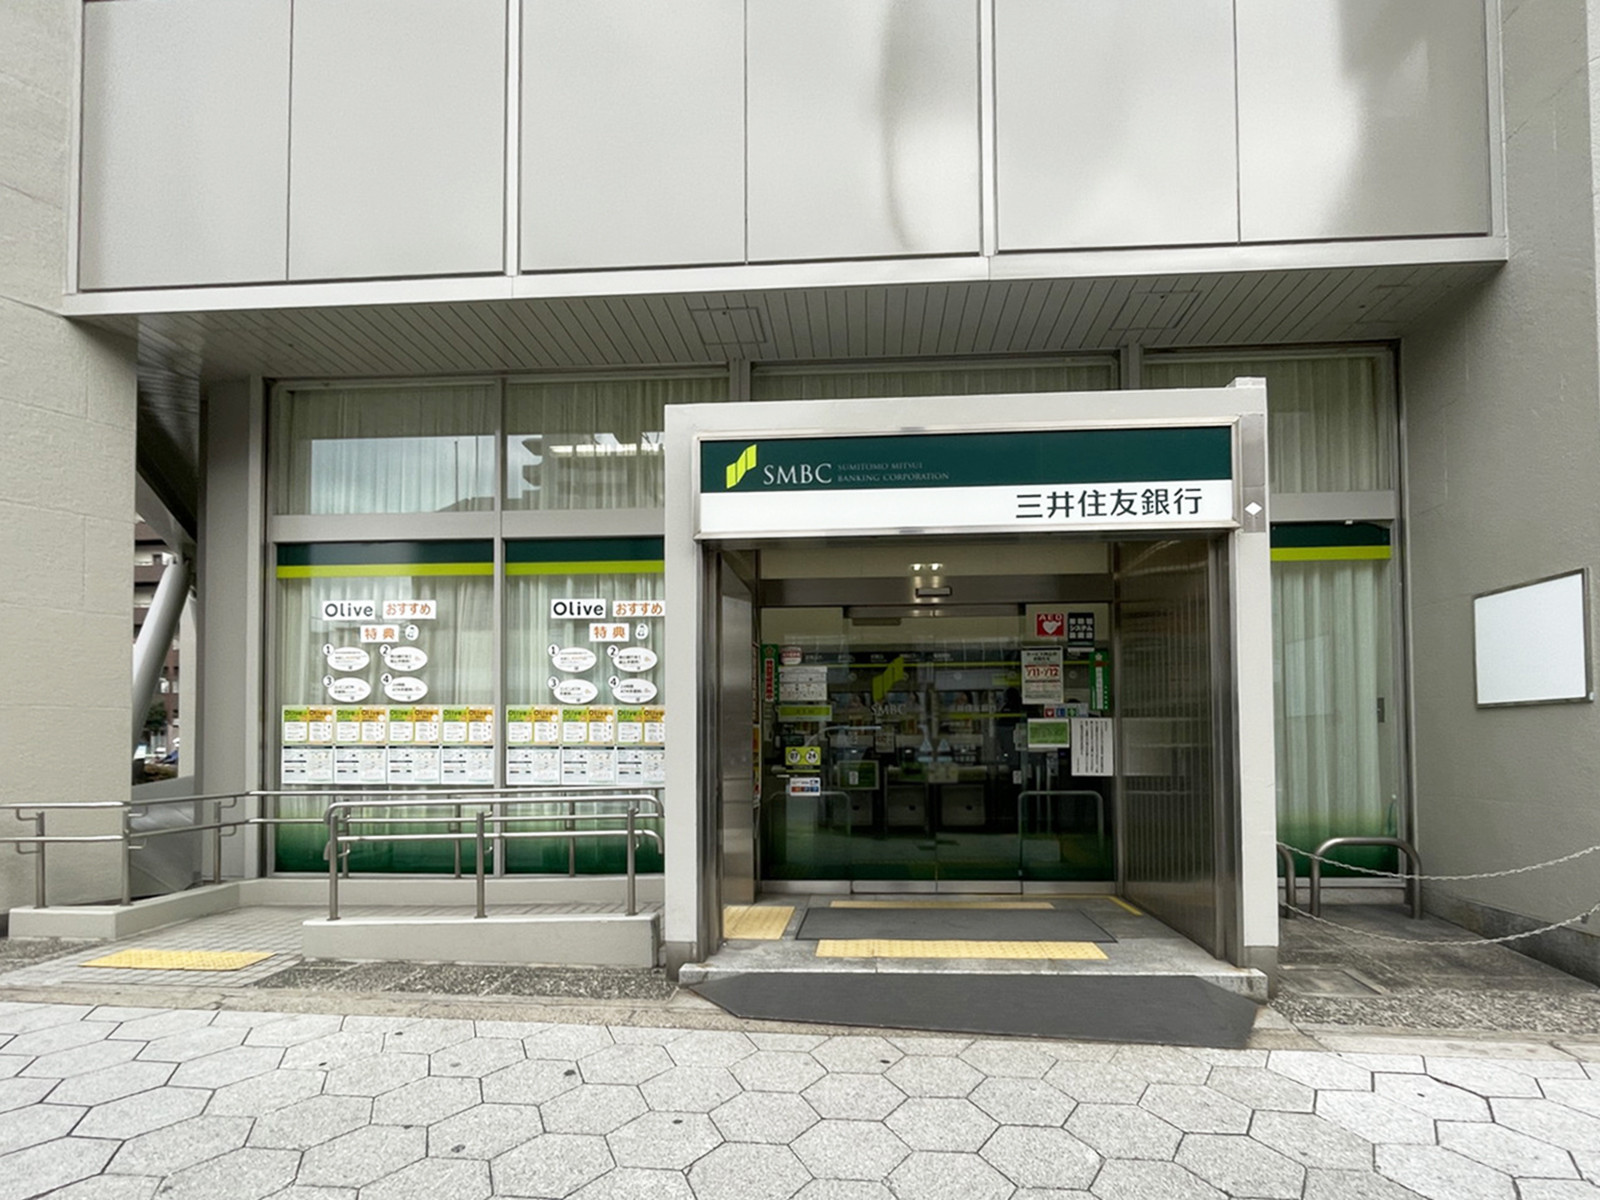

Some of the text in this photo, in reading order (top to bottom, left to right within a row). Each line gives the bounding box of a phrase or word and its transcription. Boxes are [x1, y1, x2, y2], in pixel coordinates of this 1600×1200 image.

[837, 461, 923, 471] SUMITOMO MITSUI
[763, 463, 832, 486] SMBC
[837, 472, 950, 482] BANKING CORPORATION
[1016, 487, 1203, 519] 三井住友銀行
[325, 603, 373, 618] Olive
[386, 603, 432, 616] おすすめ
[553, 601, 604, 616] Olive
[615, 603, 663, 615] おすすめ
[364, 628, 395, 640] 特典
[593, 626, 626, 639] 特典
[871, 702, 907, 715] SMBC
